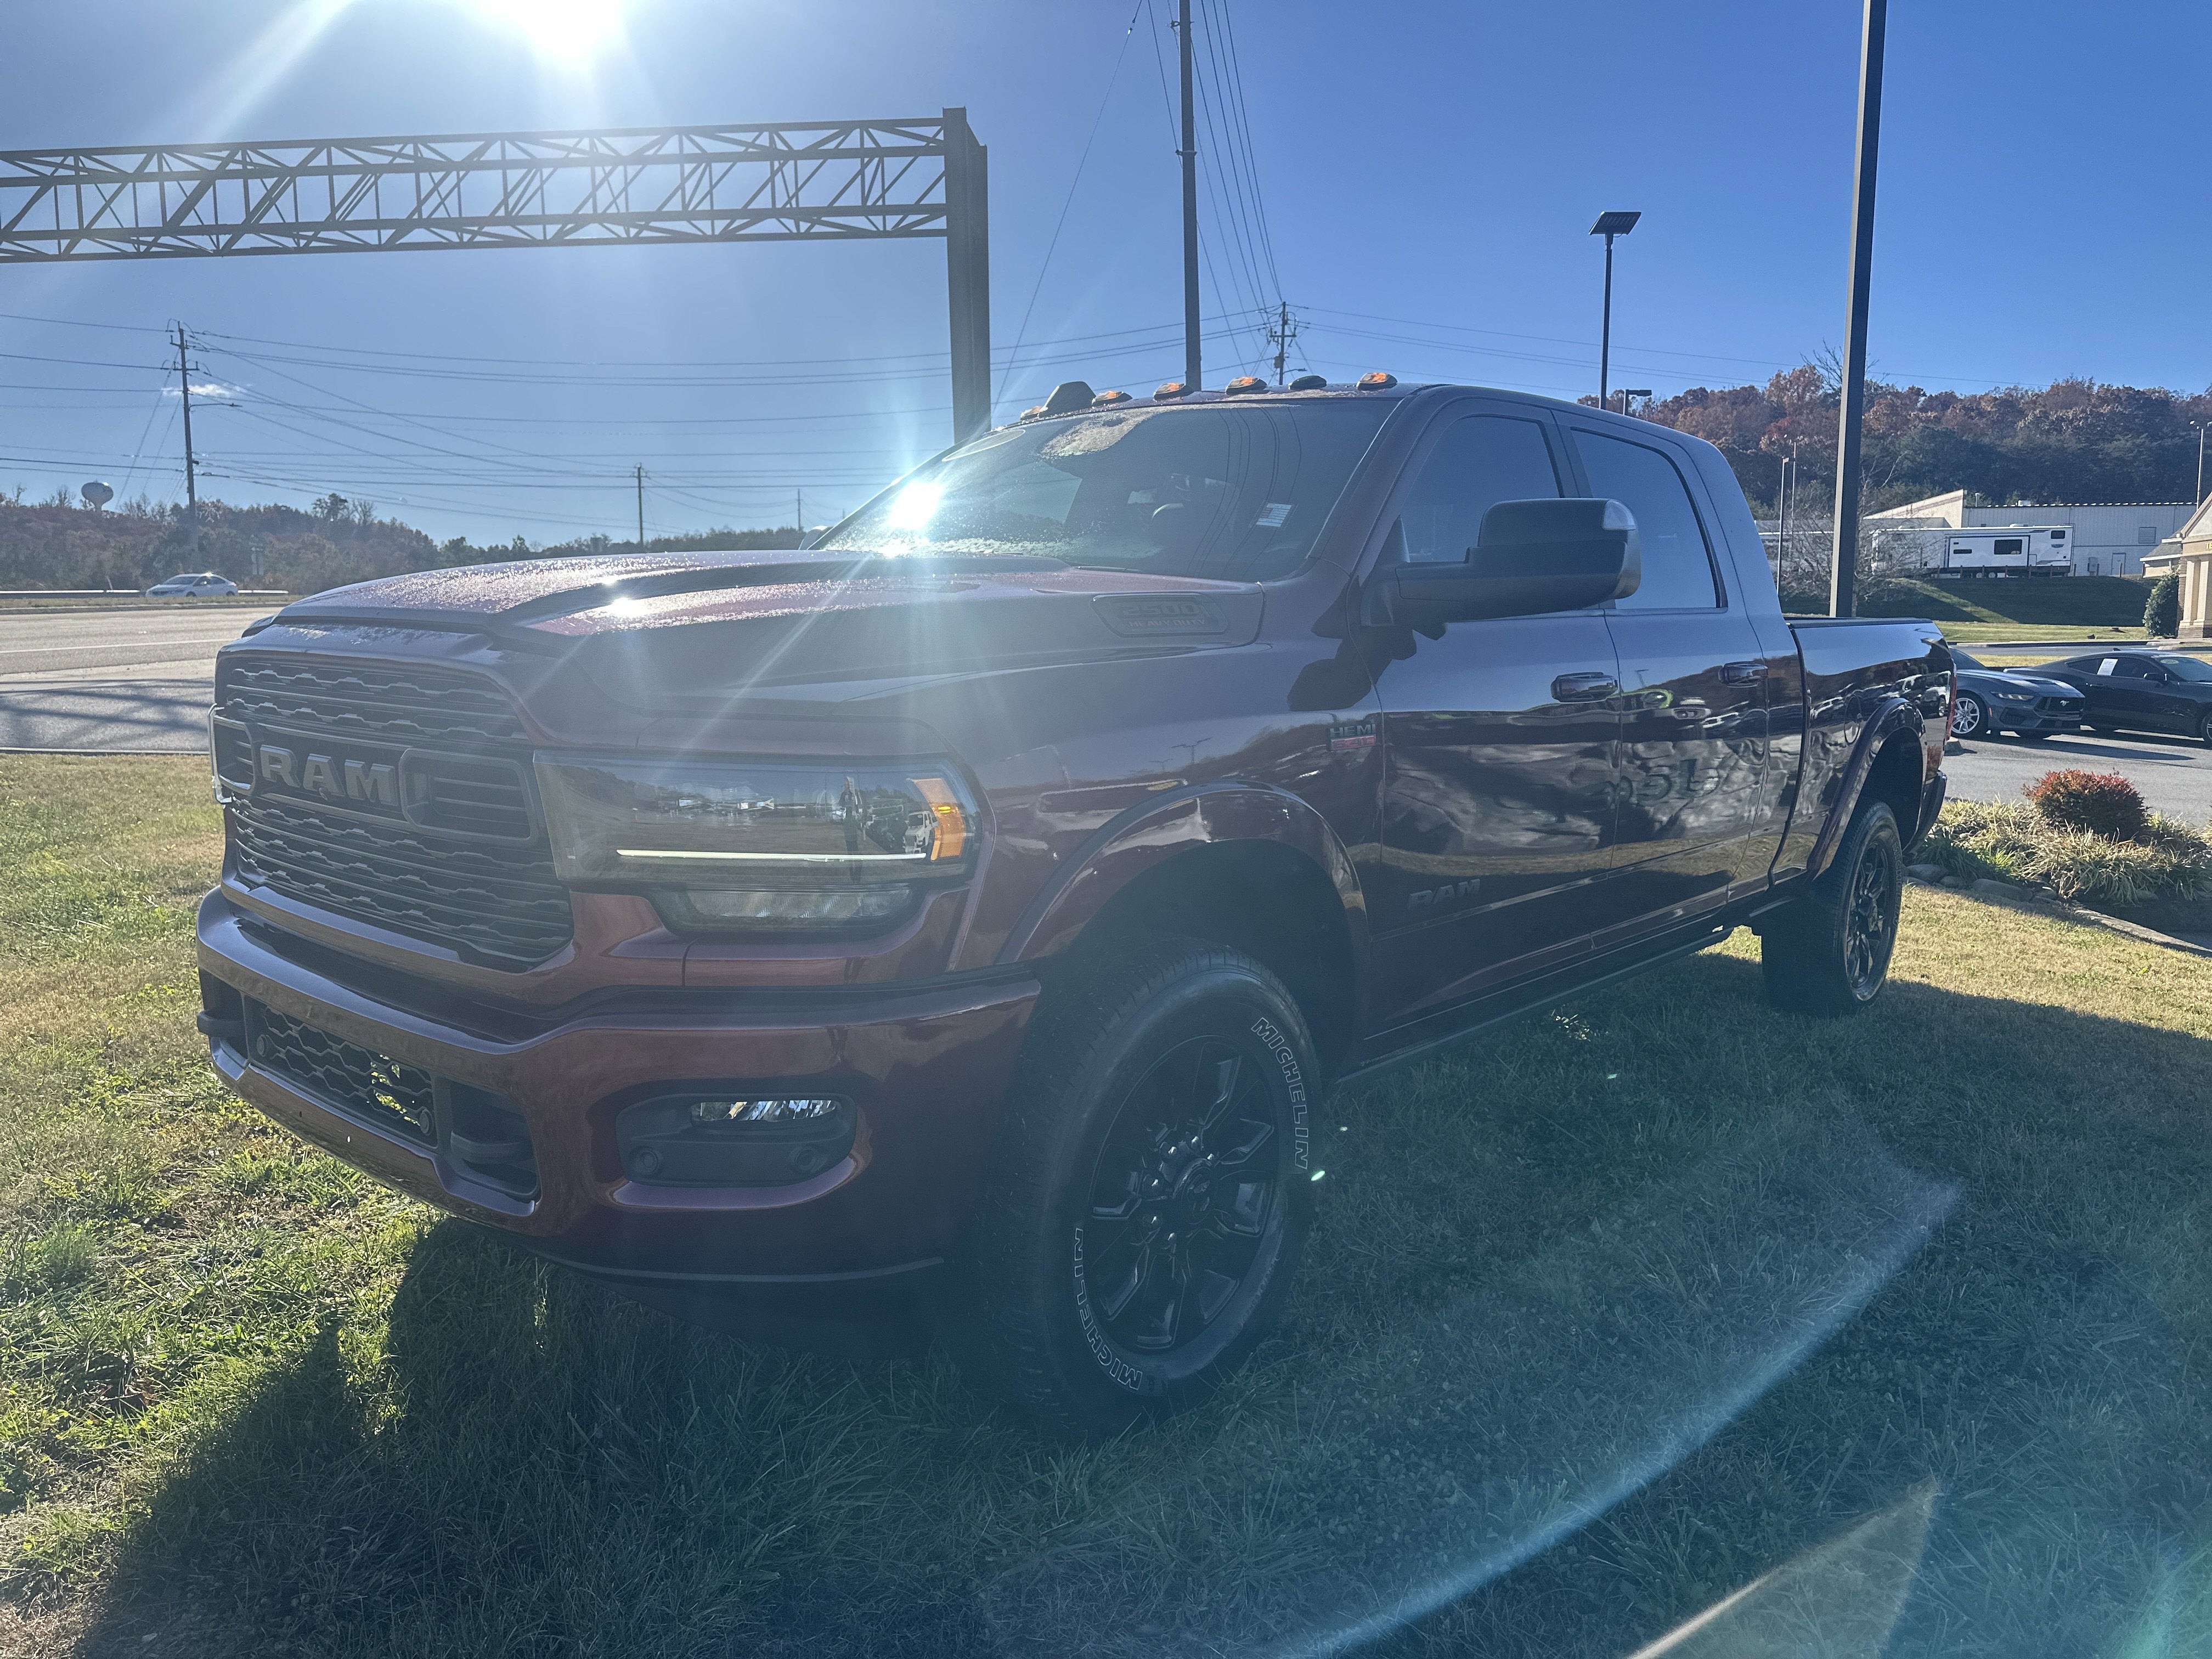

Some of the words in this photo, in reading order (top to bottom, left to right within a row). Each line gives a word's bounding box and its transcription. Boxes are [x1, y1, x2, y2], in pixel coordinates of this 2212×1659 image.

[1330, 724, 1375, 738] HEMI
[260, 744, 398, 806] RAM
[1407, 878, 1481, 910] RAM
[1250, 1017, 1308, 1170] MICHELIN
[1074, 1227, 1143, 1391] MICHELIN
